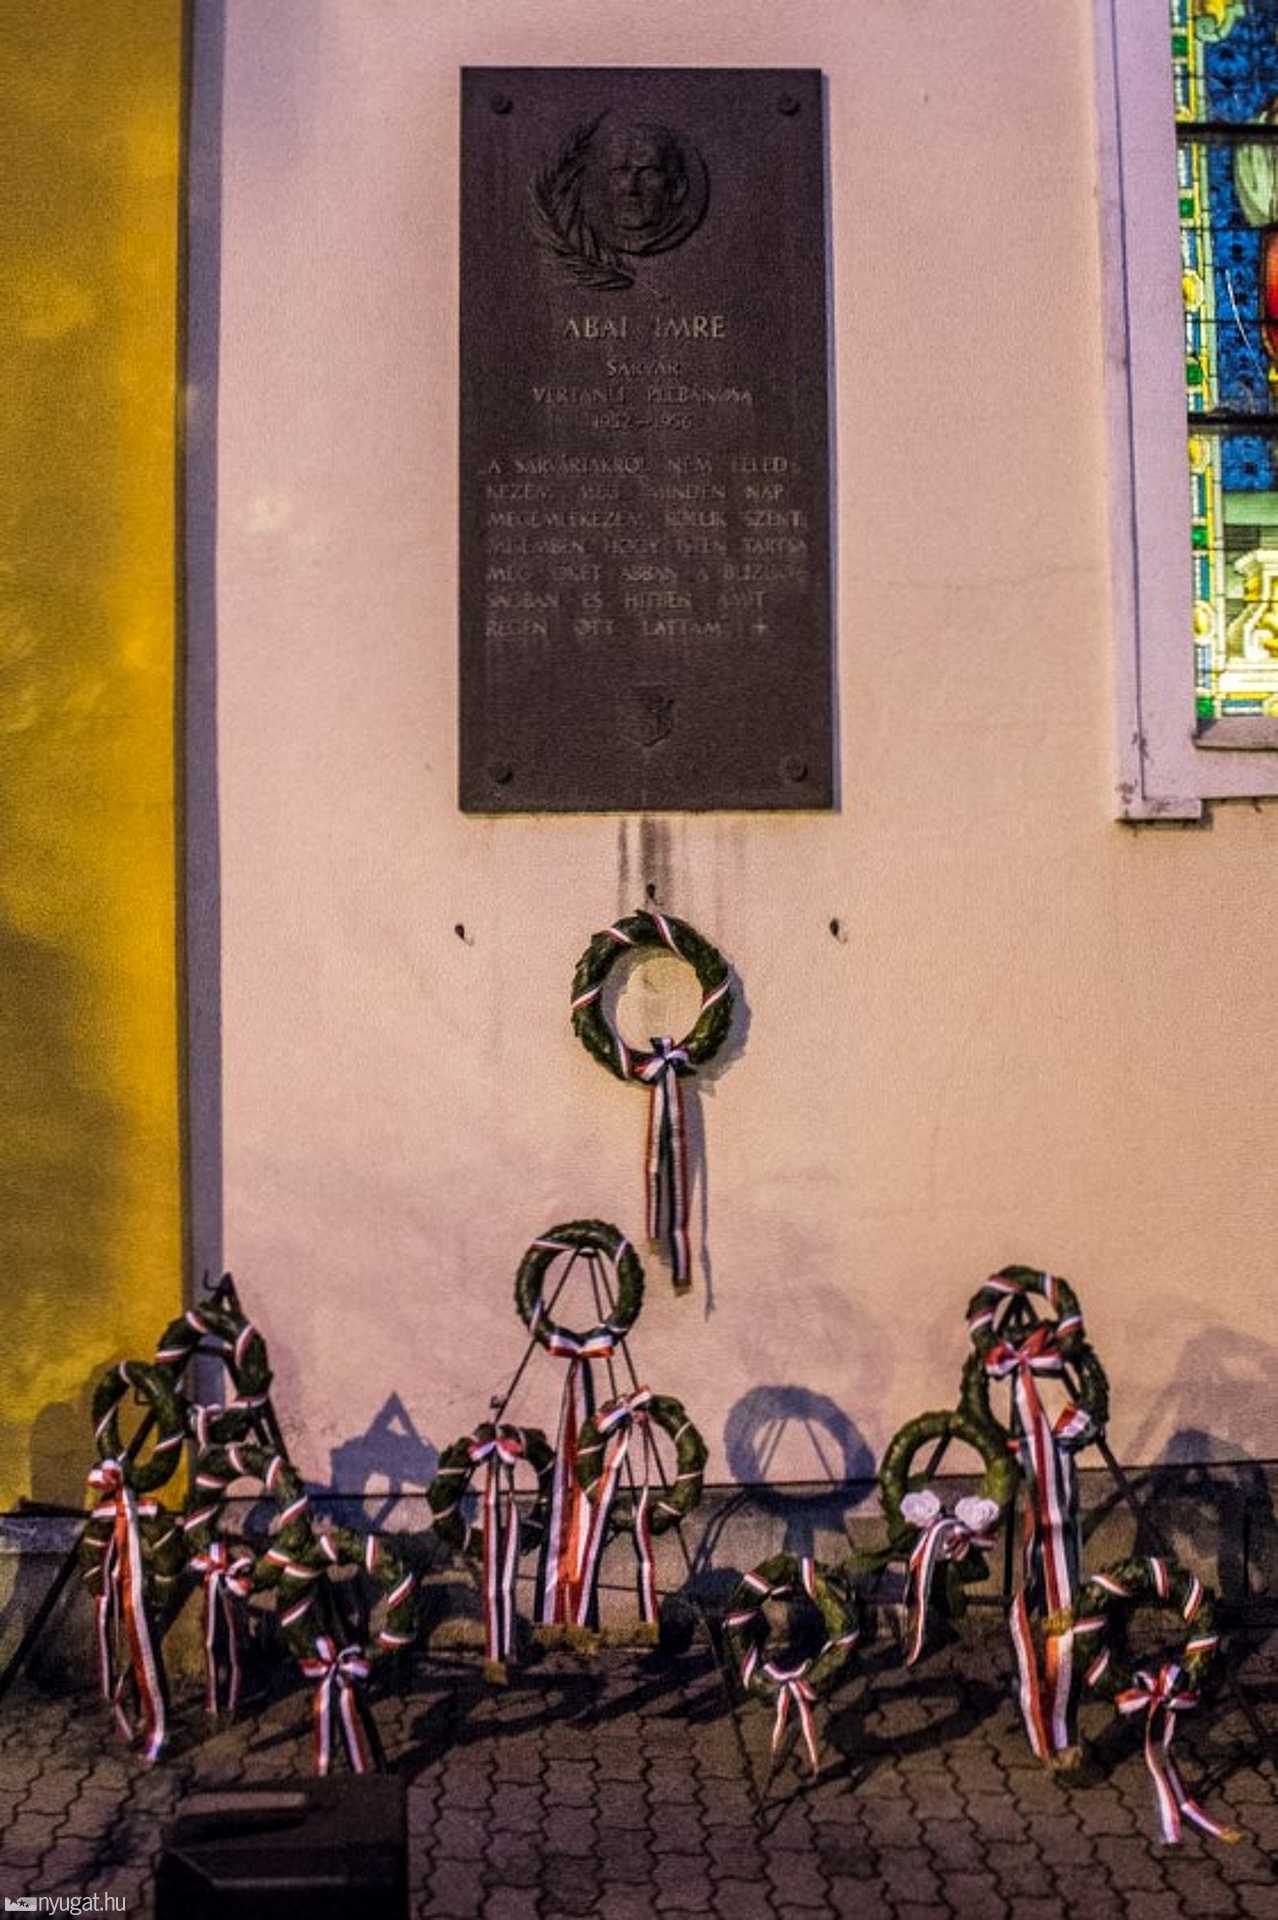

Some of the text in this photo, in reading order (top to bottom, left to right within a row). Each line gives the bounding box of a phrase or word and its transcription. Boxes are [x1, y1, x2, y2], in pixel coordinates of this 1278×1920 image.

[563, 314, 728, 338] ABAI IMRE
[488, 459, 501, 474] A
[668, 457, 713, 474] NEM
[744, 483, 785, 501] NAP
